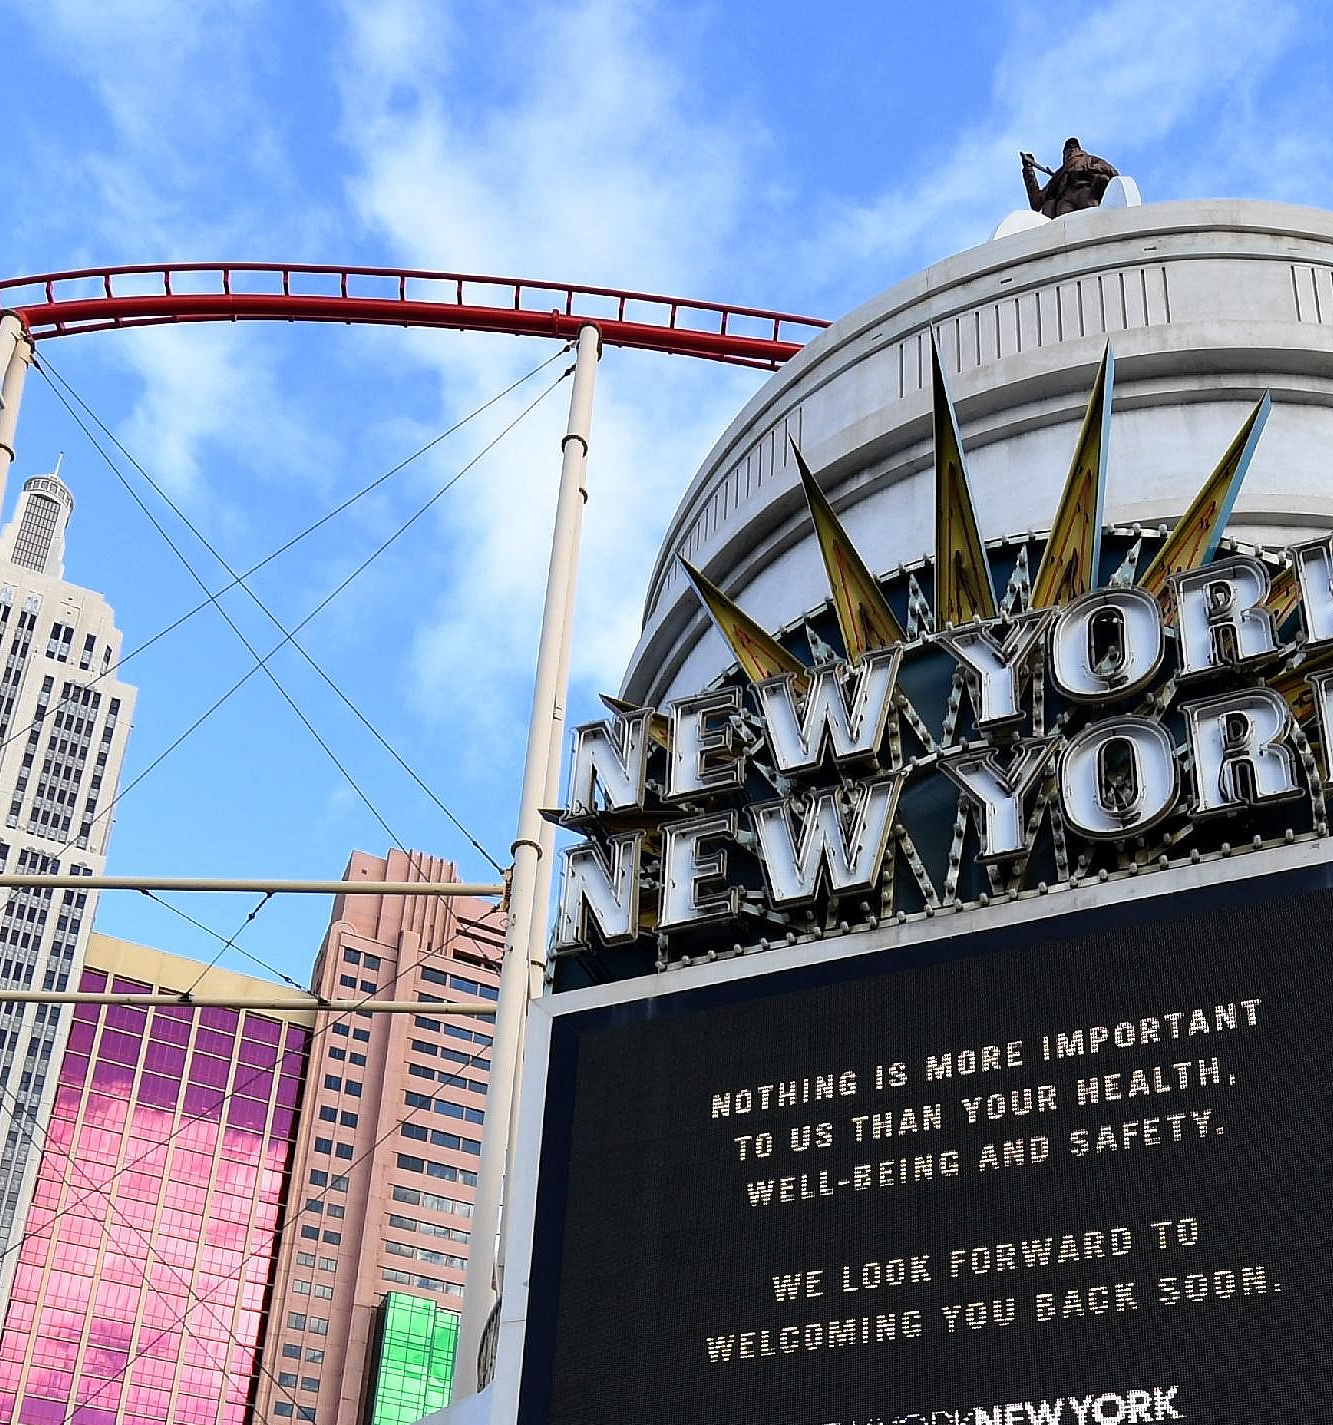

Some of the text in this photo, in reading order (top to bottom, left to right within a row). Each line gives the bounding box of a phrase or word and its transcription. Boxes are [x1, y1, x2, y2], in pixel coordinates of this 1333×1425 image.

[561, 646, 904, 828] NEW
[554, 772, 906, 953] NEW
[712, 998, 1262, 1119] NOTHING IS MORE IMPORTANT
[734, 1057, 1237, 1161] TO US THAN YOUR HEALTH,
[747, 1109, 1225, 1206] WELL-BEING AND SAFETY.
[772, 1217, 1199, 1302] WE LOOK FORWARD TO
[705, 1265, 1282, 1363] WELCOMING YOU BACK SOON.
